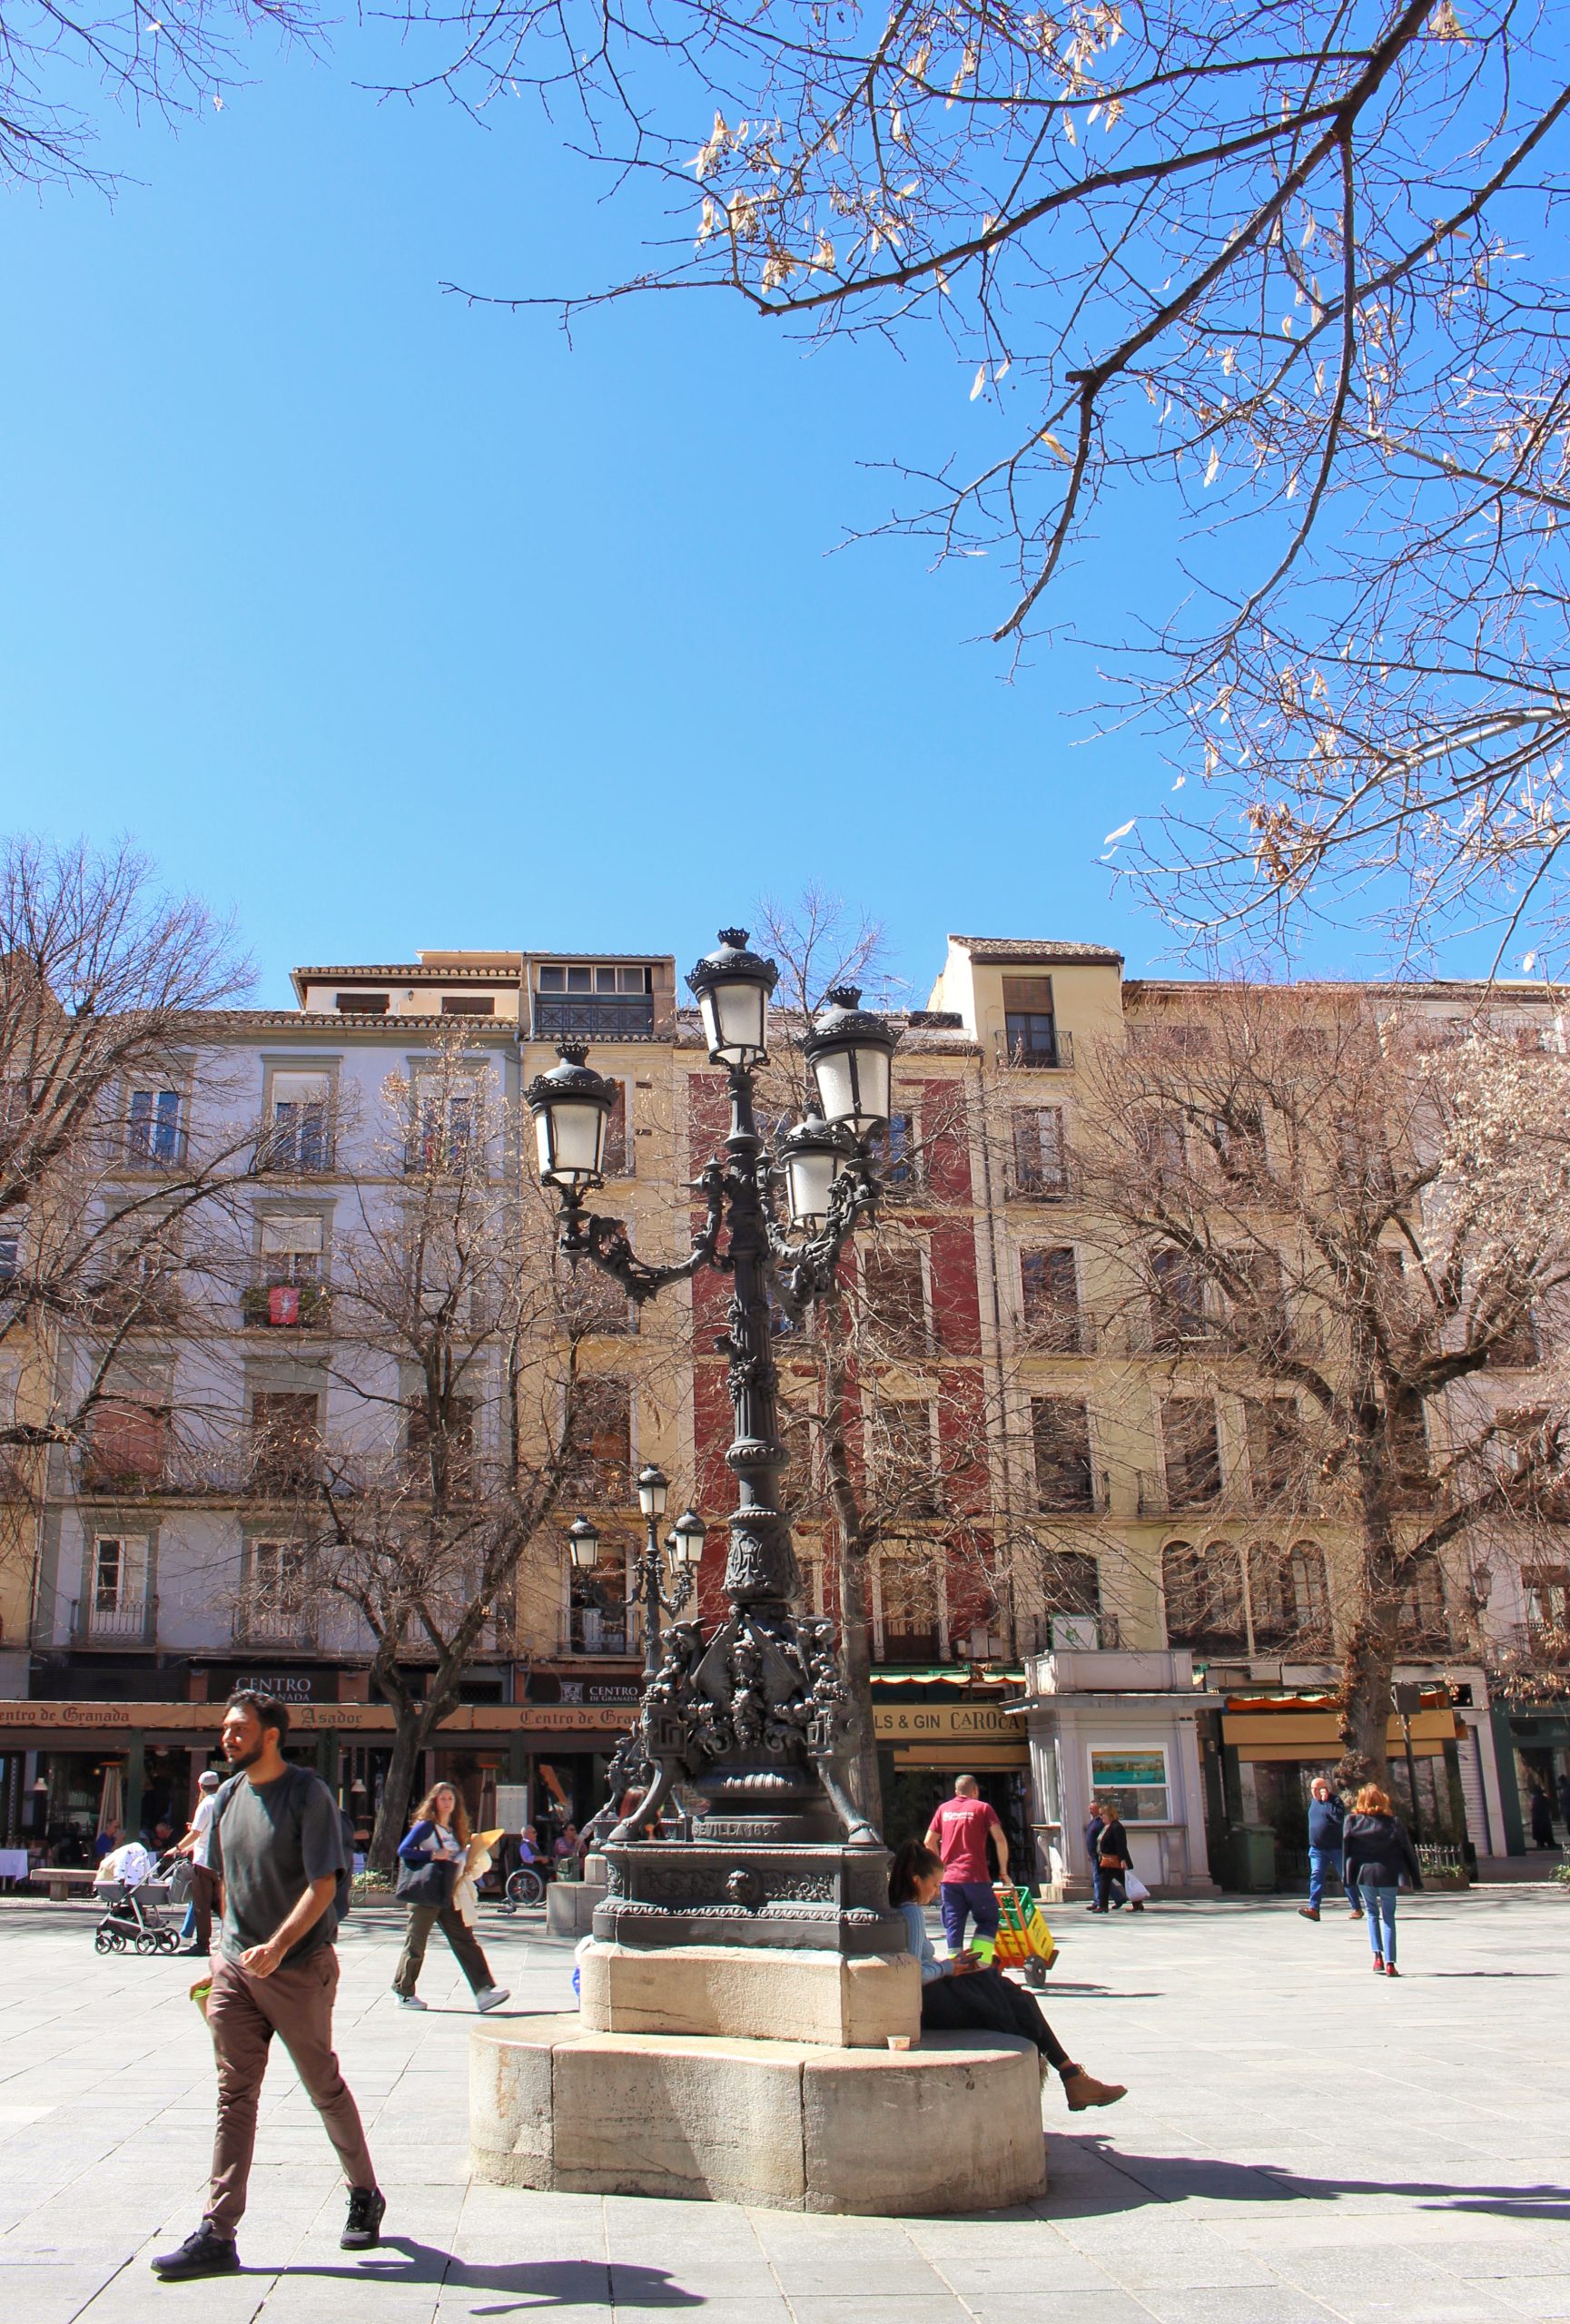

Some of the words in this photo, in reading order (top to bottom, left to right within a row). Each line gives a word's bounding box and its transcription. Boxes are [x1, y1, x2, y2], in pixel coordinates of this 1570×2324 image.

[235, 1677, 311, 1692] CENTRO
[589, 1686, 638, 1696] CENTRO
[0, 1709, 36, 1721] entro
[40, 1708, 56, 1721] de
[63, 1707, 130, 1723] Granada
[301, 1708, 363, 1725] Asador
[519, 1709, 575, 1725] Centro
[578, 1710, 594, 1724] de
[600, 1709, 641, 1725] Gran
[898, 1715, 909, 1728] &
[913, 1714, 941, 1728] GIN
